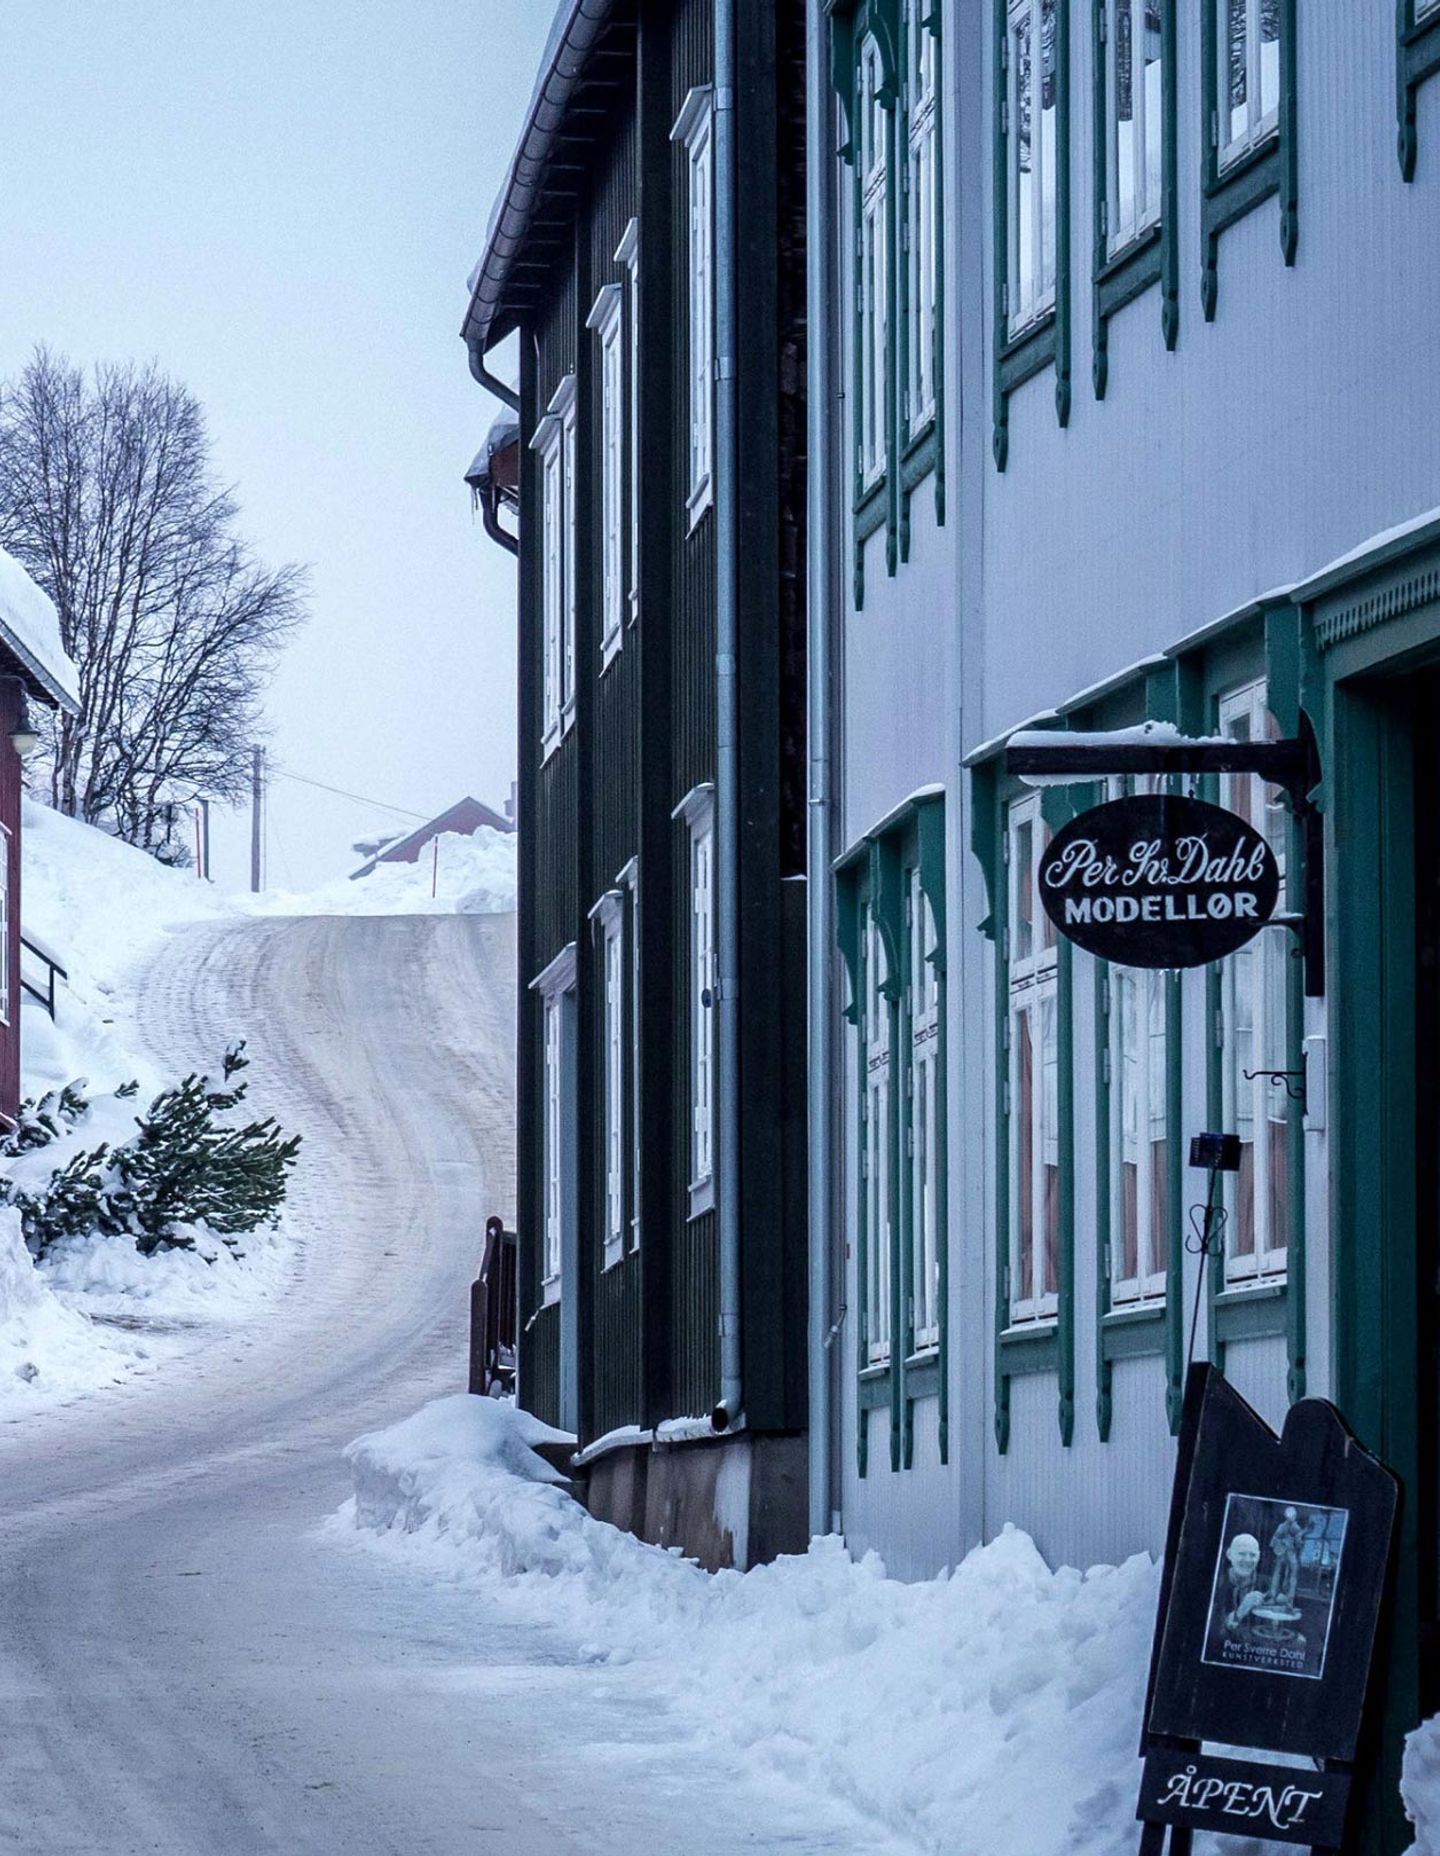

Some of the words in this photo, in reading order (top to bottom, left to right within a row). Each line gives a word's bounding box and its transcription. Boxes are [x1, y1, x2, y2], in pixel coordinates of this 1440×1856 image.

[1044, 837, 1121, 888] Per
[1168, 832, 1266, 885] Dahl
[1064, 892, 1259, 925] MODELLØR
[1223, 1639, 1242, 1652] Per
[1244, 1642, 1278, 1657] Sverre
[1280, 1648, 1306, 1661] Dahl
[1157, 1765, 1323, 1829] ÅPENT
